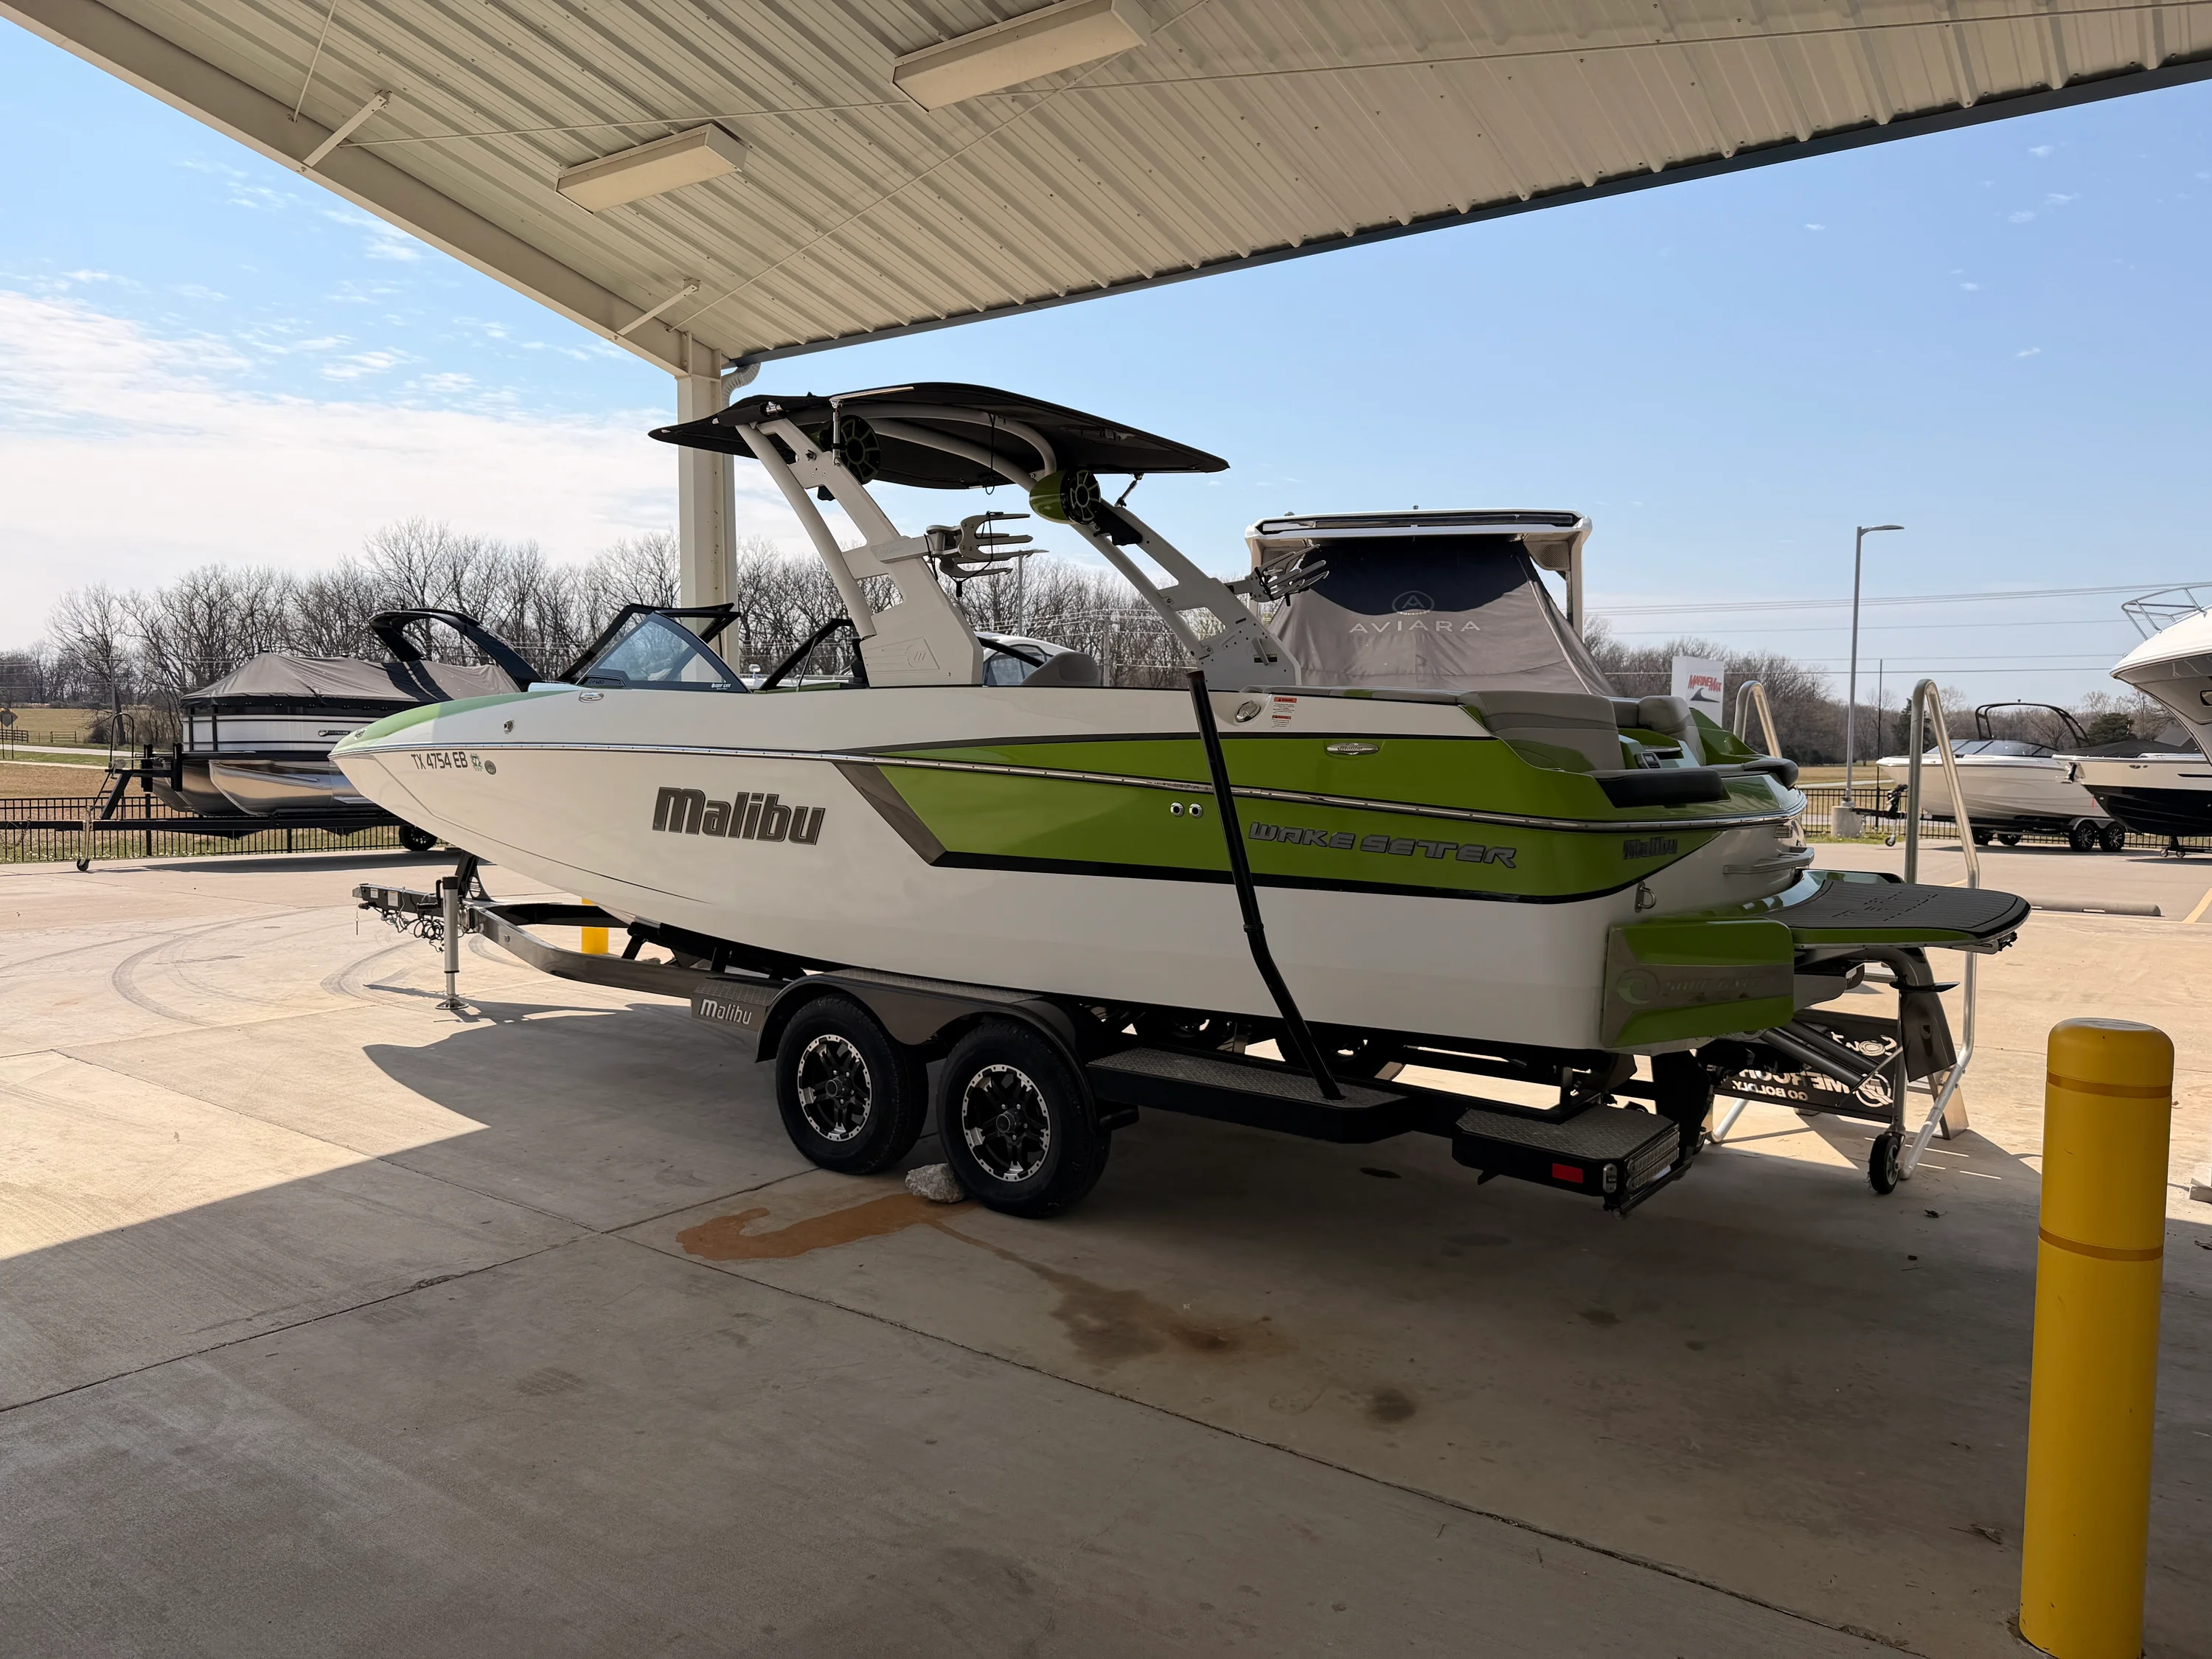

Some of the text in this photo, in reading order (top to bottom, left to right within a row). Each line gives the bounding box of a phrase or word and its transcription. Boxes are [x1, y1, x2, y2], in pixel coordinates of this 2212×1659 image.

[1349, 619, 1481, 633] AVIARA
[411, 754, 426, 770] TX
[426, 752, 452, 769] 4754
[452, 751, 468, 768] EB
[653, 787, 826, 845] Malibu
[1622, 836, 1677, 860] Malibu
[698, 998, 752, 1025] Malibu
